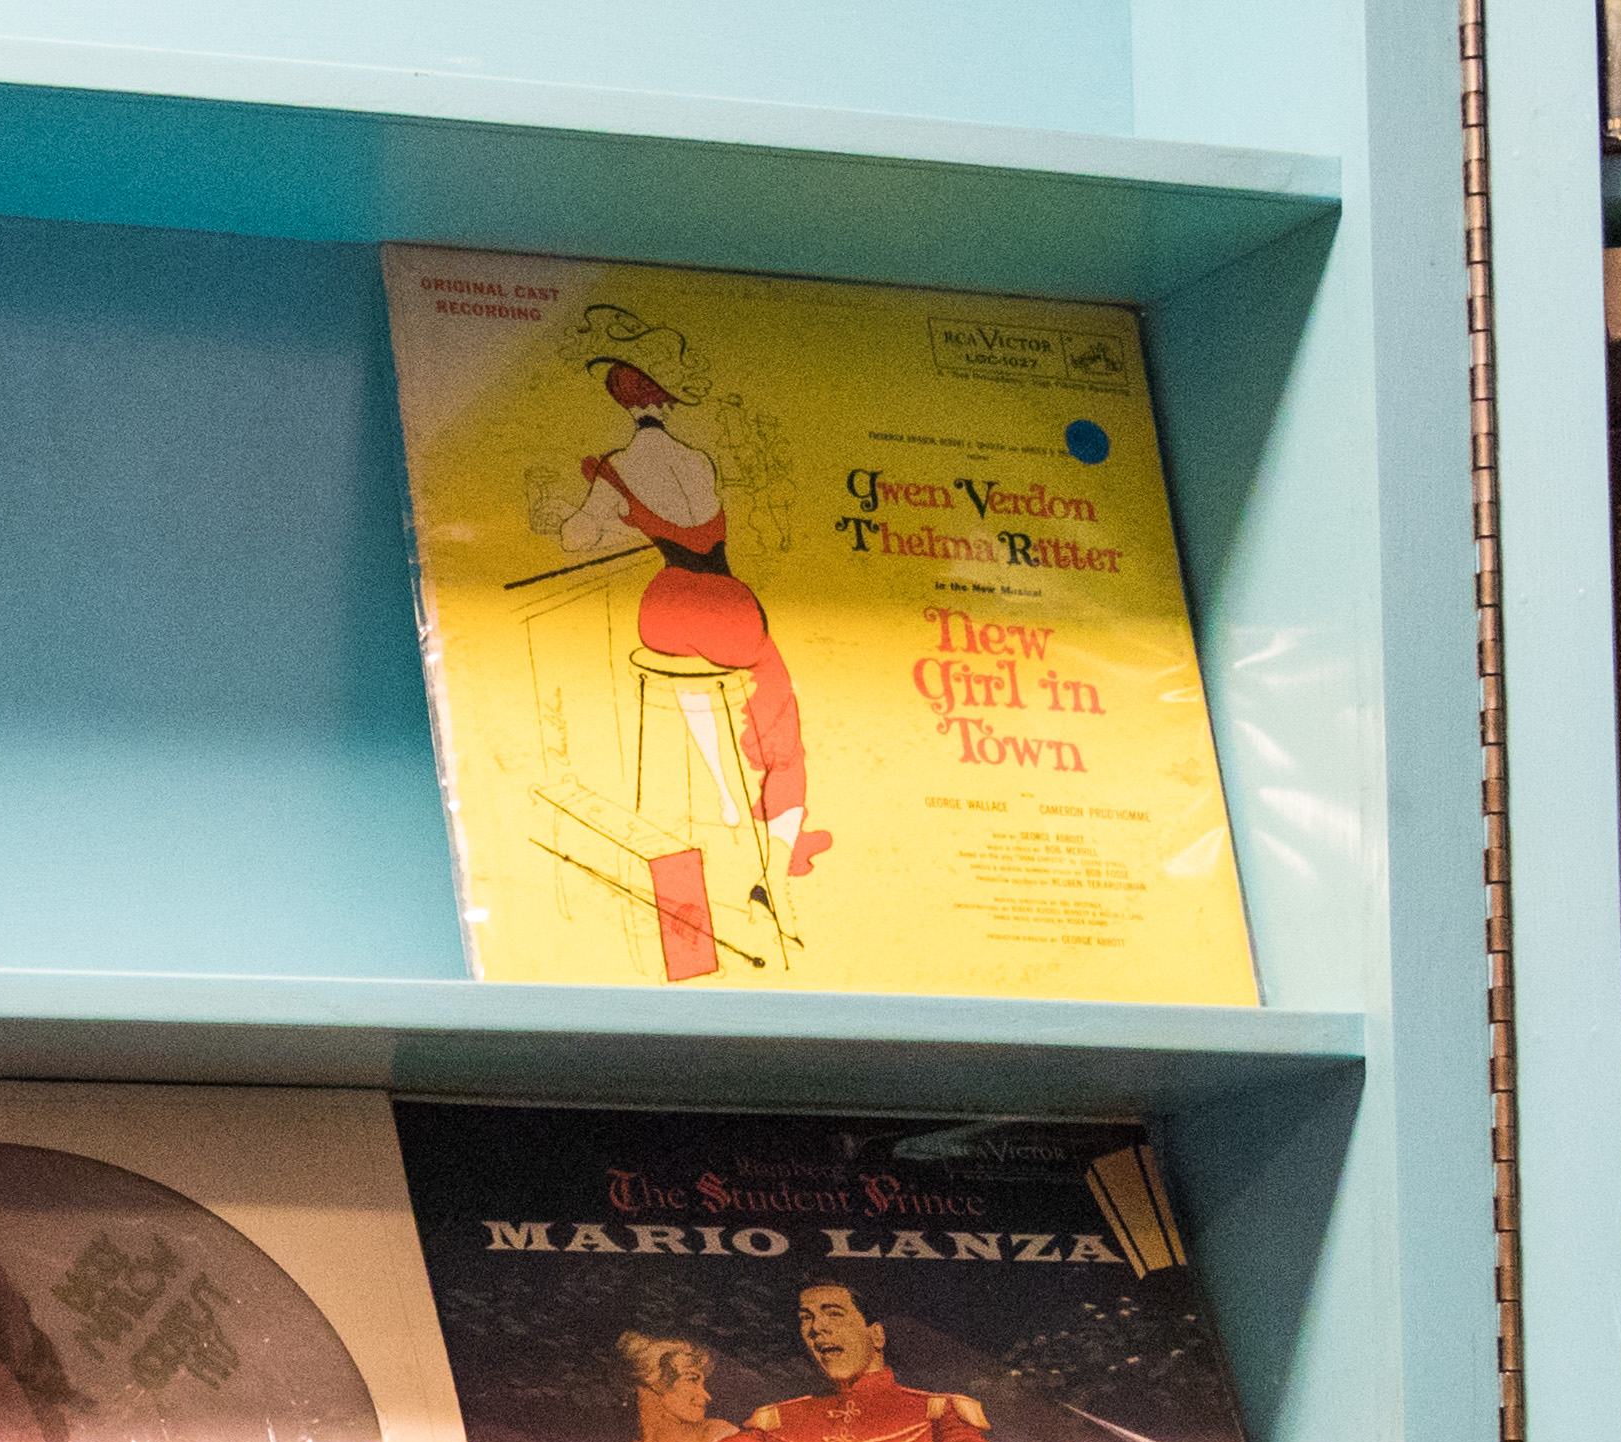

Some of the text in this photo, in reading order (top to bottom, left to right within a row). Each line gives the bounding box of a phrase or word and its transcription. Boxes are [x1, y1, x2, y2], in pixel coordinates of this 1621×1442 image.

[847, 468, 1099, 522] Gwen Verdon
[835, 516, 1123, 573] Thelma Ritter
[912, 657, 1106, 716] Girl in
[936, 716, 1087, 773] Town
[483, 1218, 1128, 1264] MARIO LANZA
